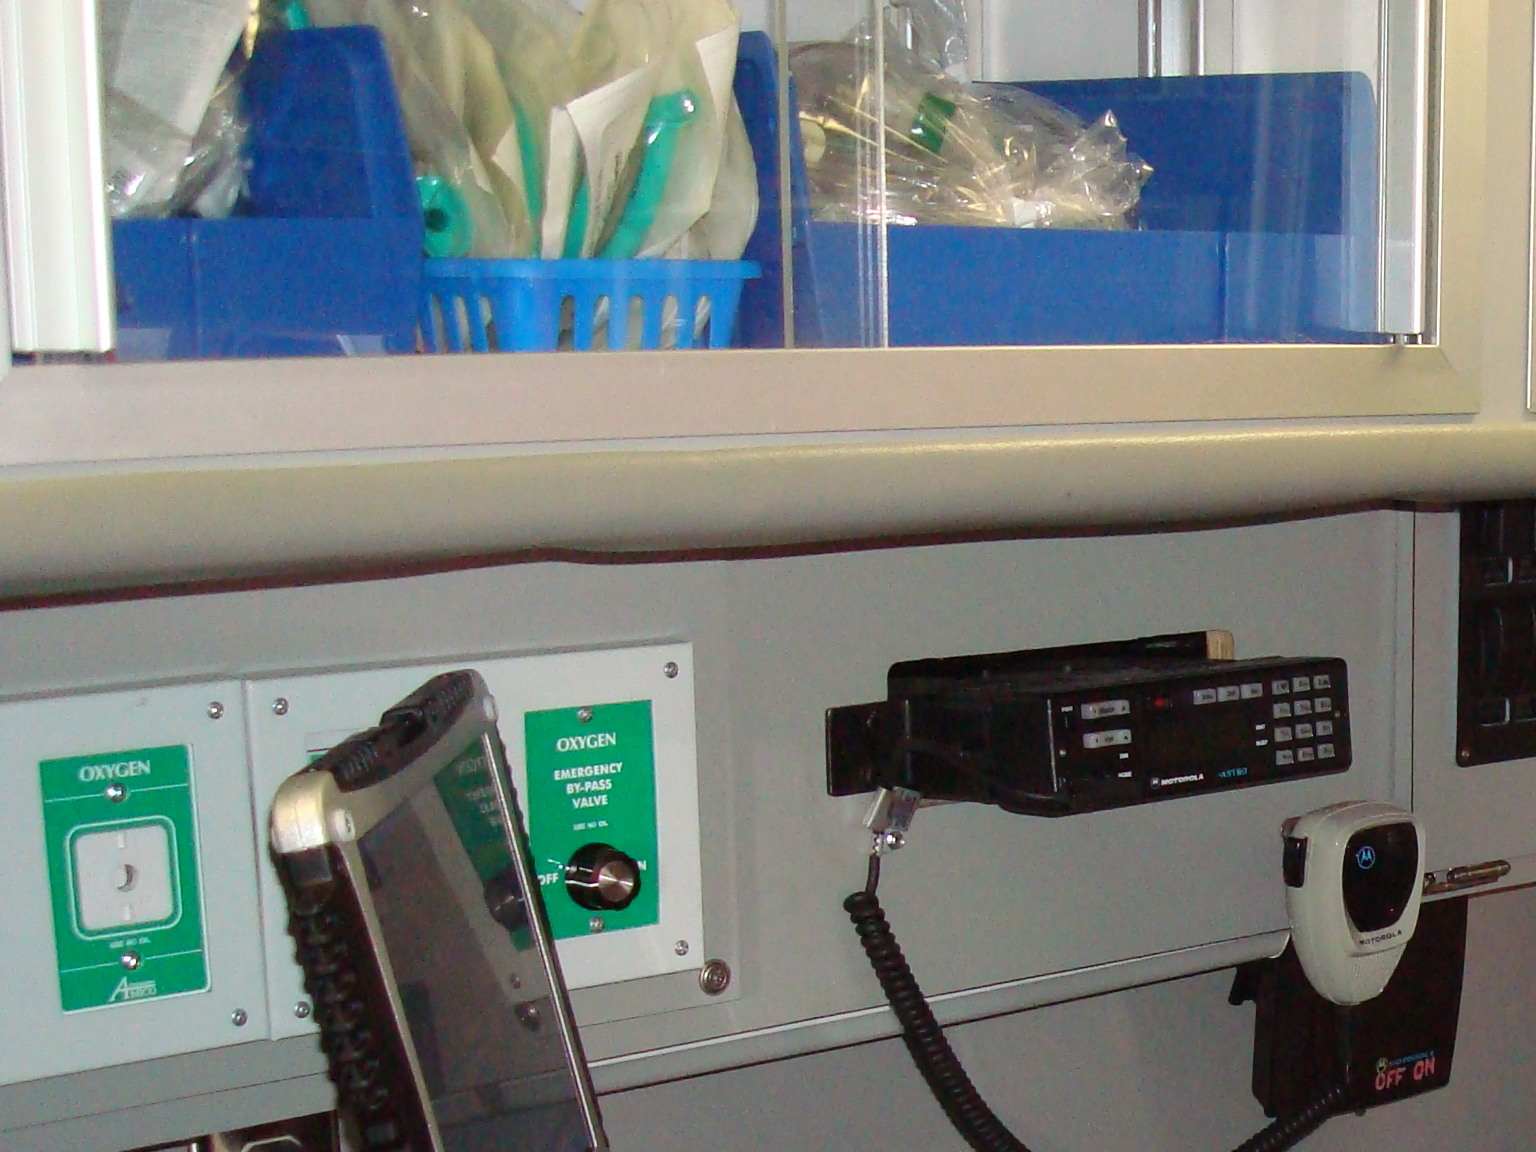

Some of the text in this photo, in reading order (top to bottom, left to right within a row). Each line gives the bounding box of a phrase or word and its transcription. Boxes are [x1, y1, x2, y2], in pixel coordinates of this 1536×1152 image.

[555, 732, 617, 752] OXYGEN
[78, 760, 151, 782] OXYGEN
[554, 762, 622, 780] EMERGENCY
[1160, 773, 1204, 786] MOTOROLA
[566, 778, 613, 795] BY-PASS
[571, 794, 609, 809] VALVE
[1359, 929, 1403, 945] MOTOROLA
[1374, 1056, 1436, 1091] OFF ON
